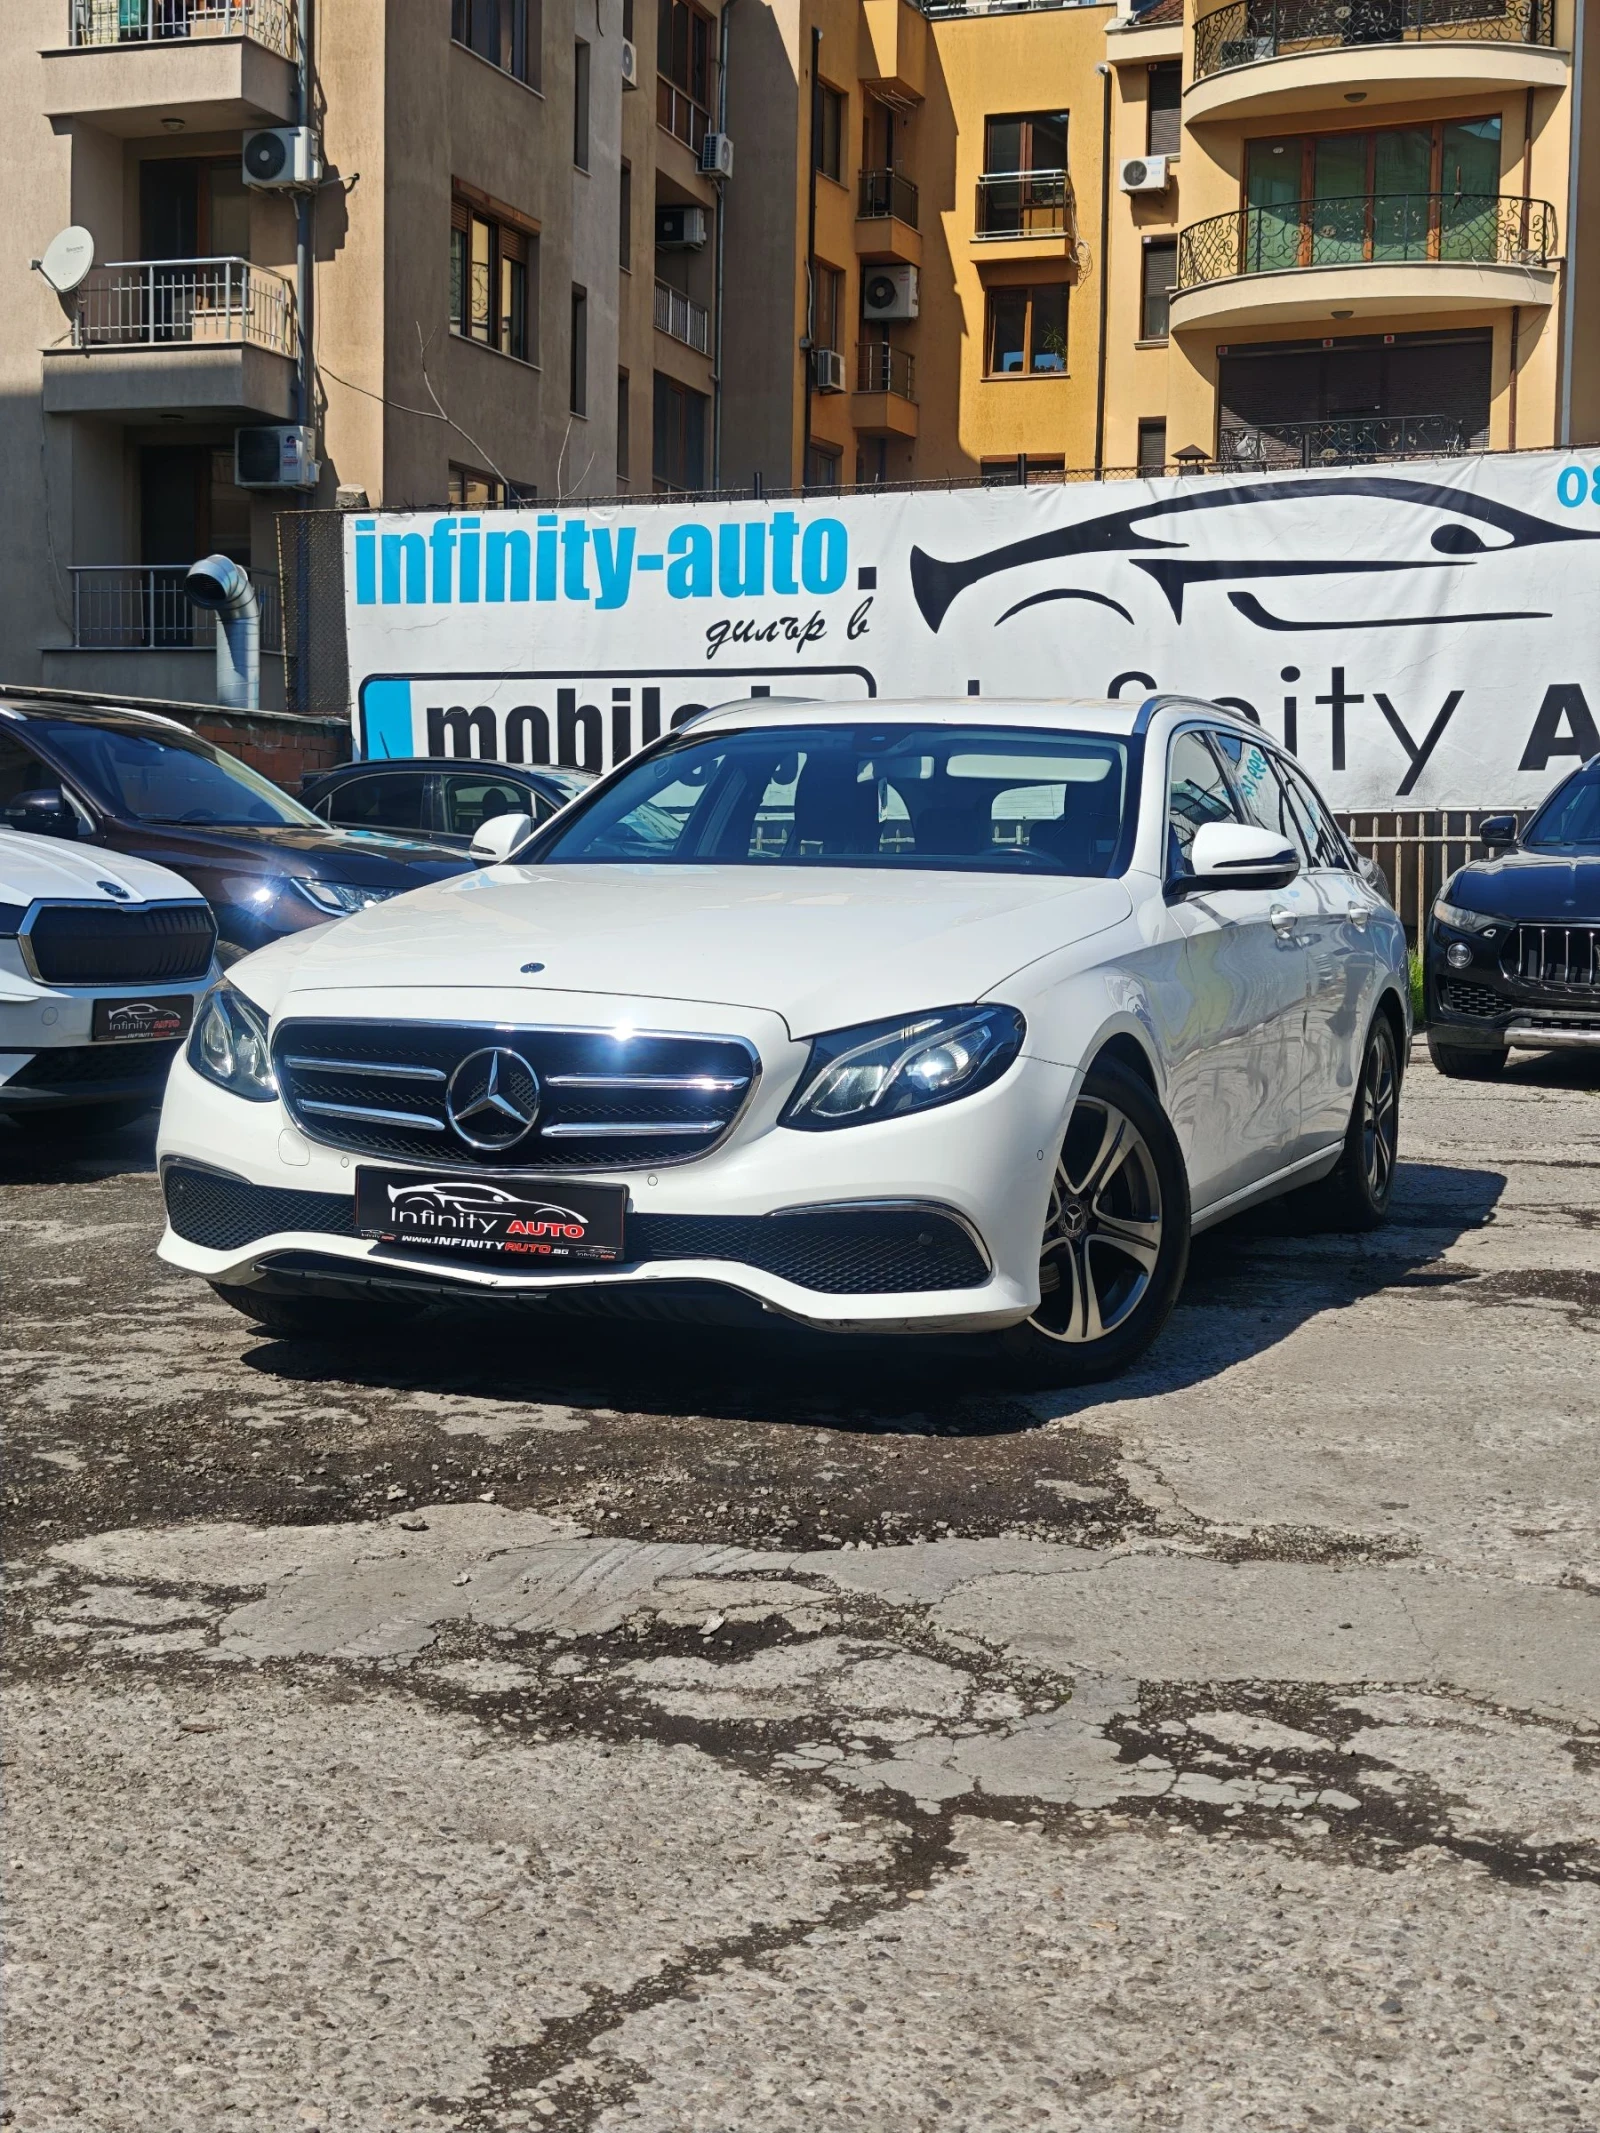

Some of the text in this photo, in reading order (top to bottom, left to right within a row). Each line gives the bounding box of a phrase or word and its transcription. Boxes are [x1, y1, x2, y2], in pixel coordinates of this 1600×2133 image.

[1557, 465, 1600, 508] 0
[705, 596, 874, 660] дилър в
[109, 1020, 151, 1030] Infinity
[391, 1206, 585, 1239] Infinity AUTO
